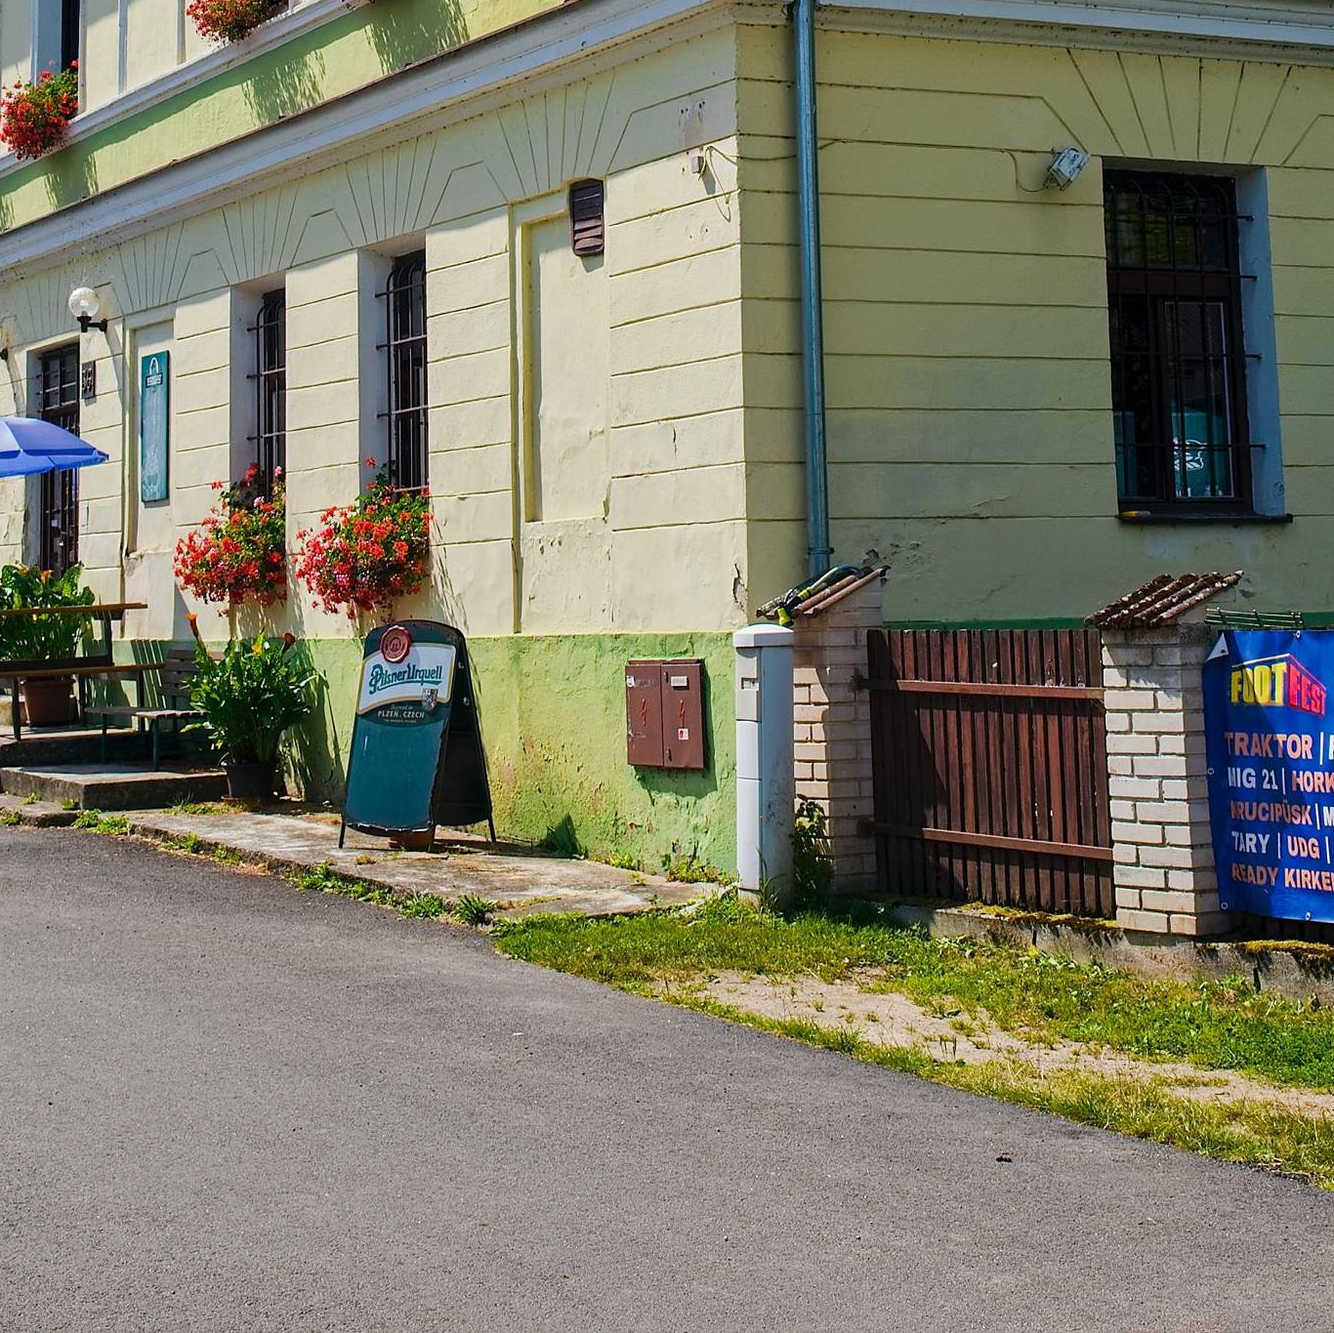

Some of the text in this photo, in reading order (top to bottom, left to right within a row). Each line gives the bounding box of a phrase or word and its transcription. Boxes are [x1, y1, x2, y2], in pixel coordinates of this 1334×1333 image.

[369, 662, 443, 695] Pilsner Urquell
[1224, 731, 1313, 760] TRAKTOR
[1261, 768, 1279, 790] 21
[1287, 835, 1321, 859] UDG
